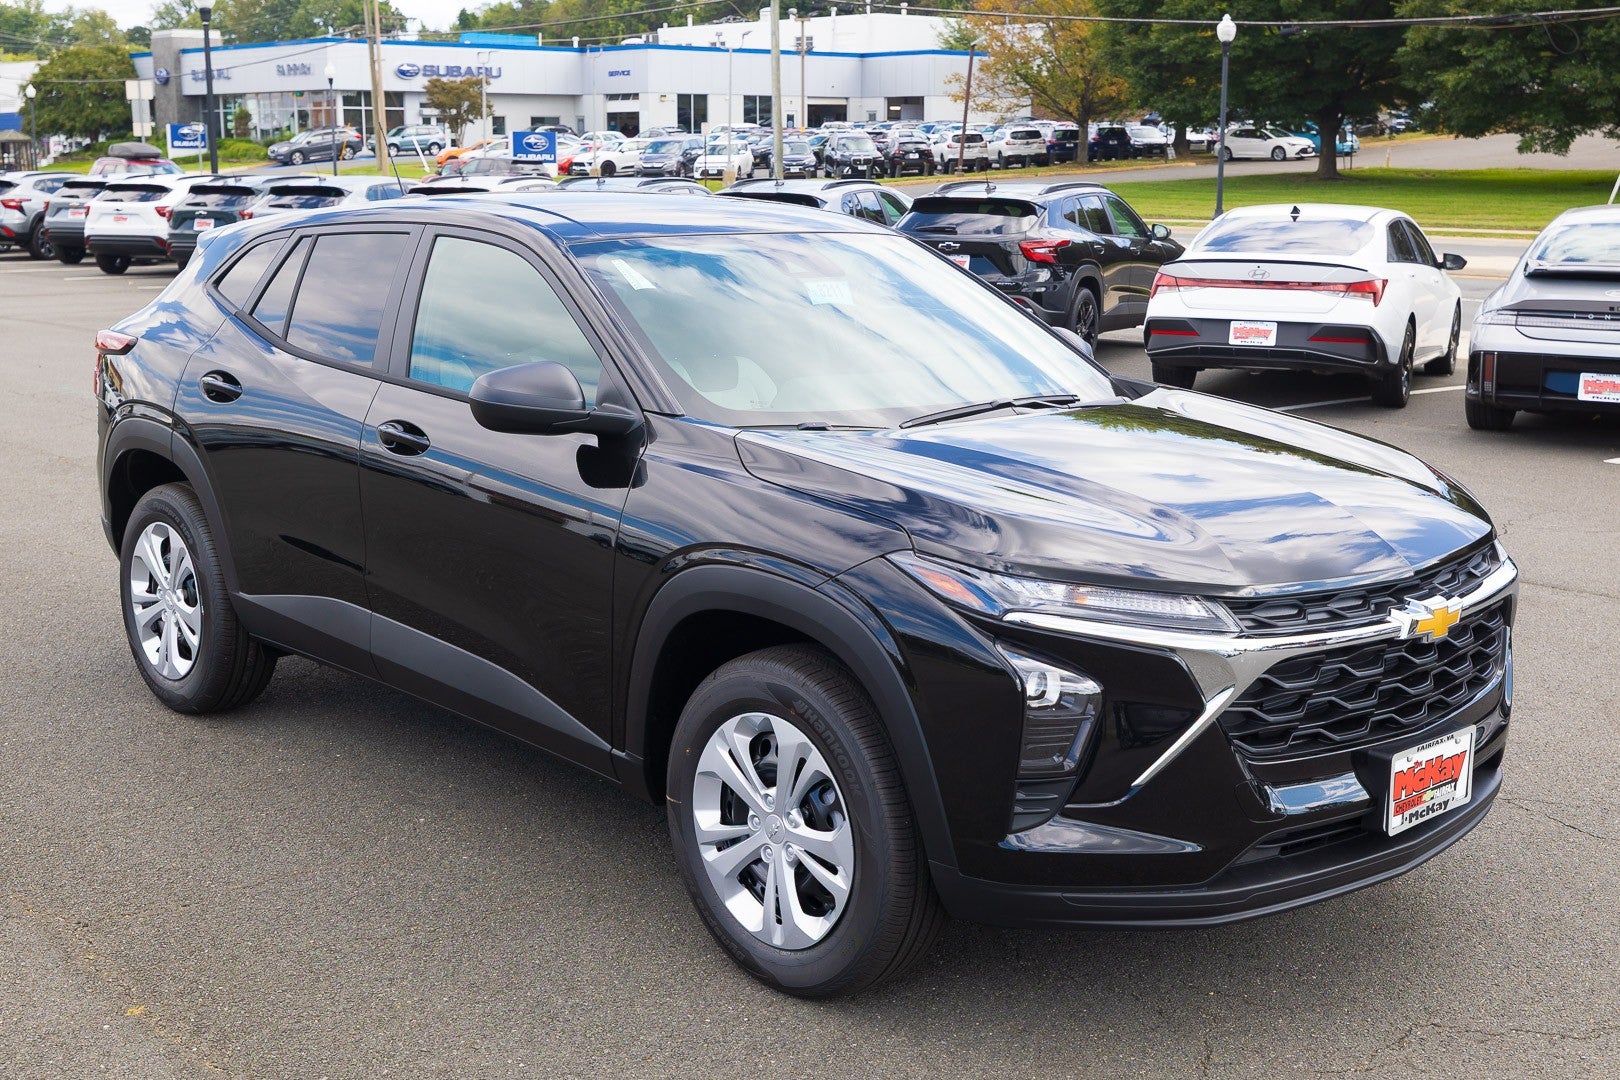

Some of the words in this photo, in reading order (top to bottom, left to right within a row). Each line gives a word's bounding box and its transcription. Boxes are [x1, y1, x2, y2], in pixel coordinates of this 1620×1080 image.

[422, 64, 502, 79] SUBARU
[608, 69, 631, 78] SERVICE
[515, 153, 555, 161] SUBARU
[1394, 750, 1467, 799] McKay
